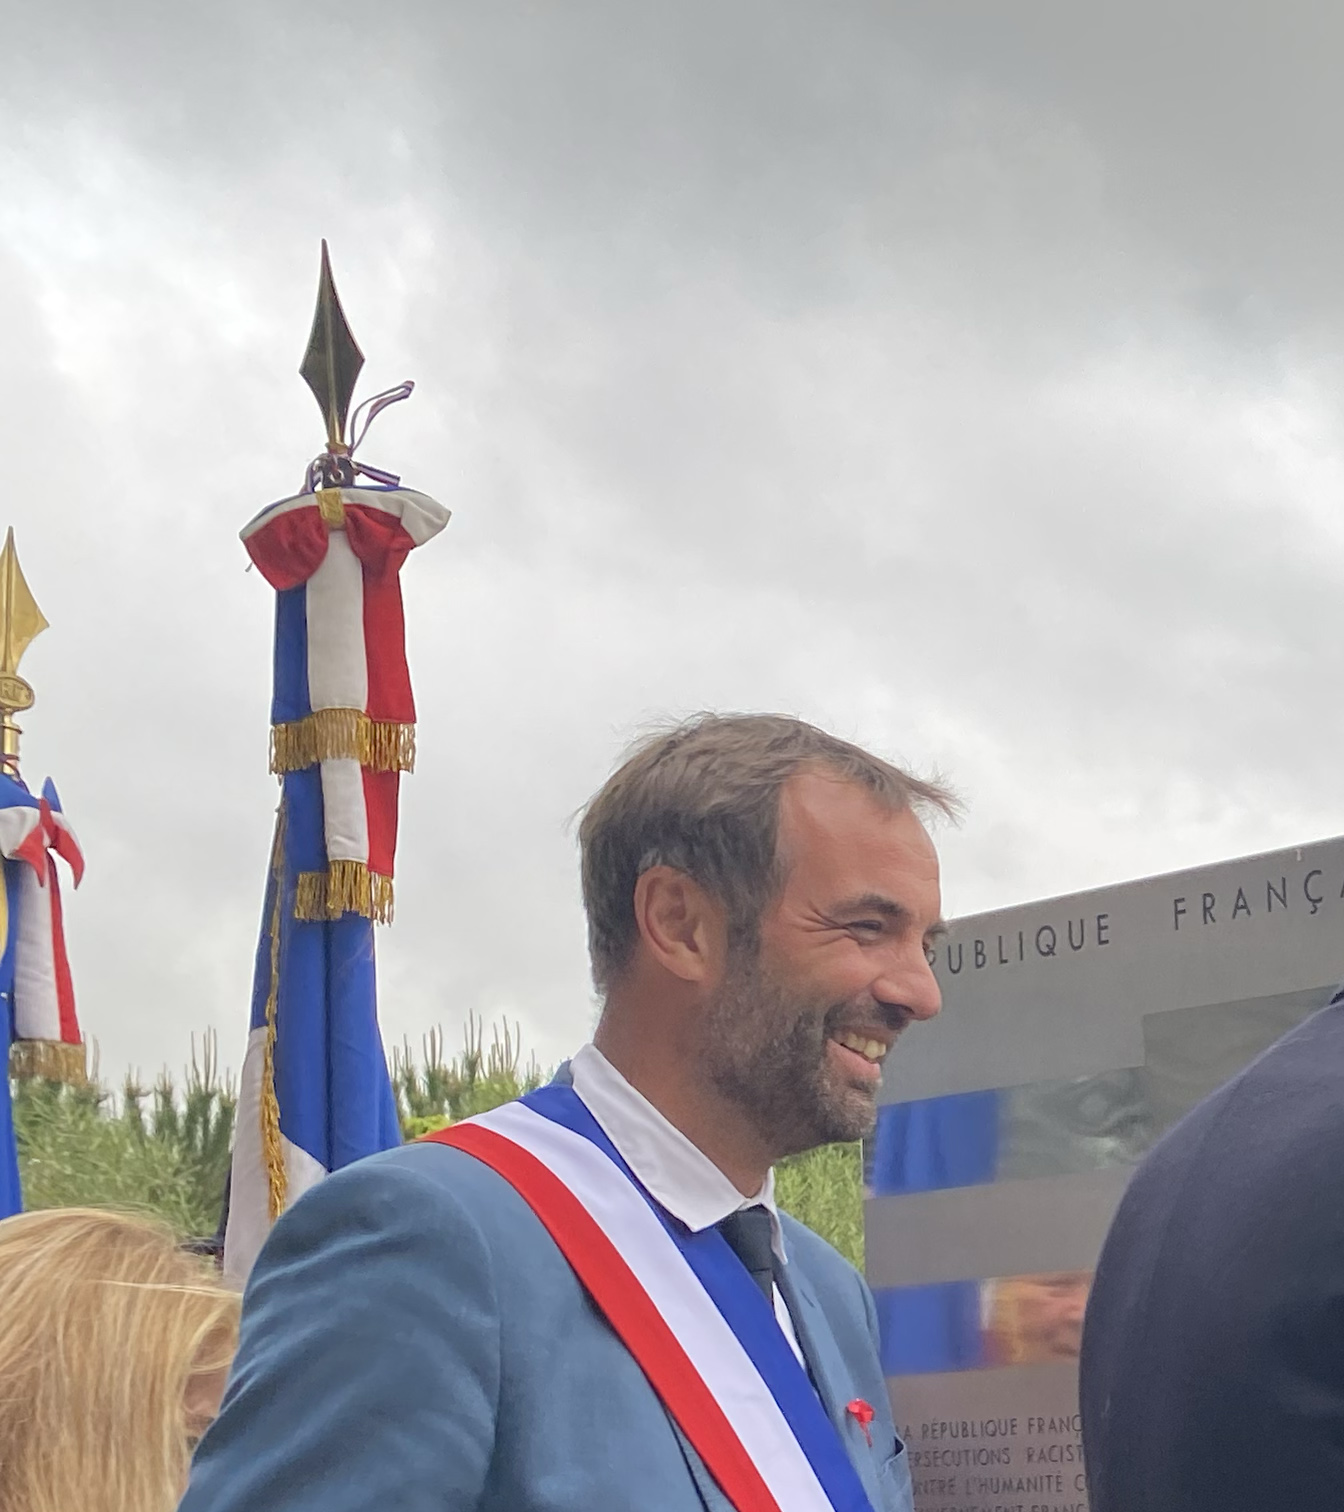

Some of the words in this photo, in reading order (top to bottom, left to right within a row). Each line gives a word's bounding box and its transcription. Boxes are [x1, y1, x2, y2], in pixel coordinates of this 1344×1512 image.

[922, 1417, 1018, 1439] RÉPUBLIQUE
[1027, 1444, 1084, 1464] RACIST
[913, 1478, 956, 1496] NTRE
[965, 1471, 1063, 1495] L'HUMANITÉ
